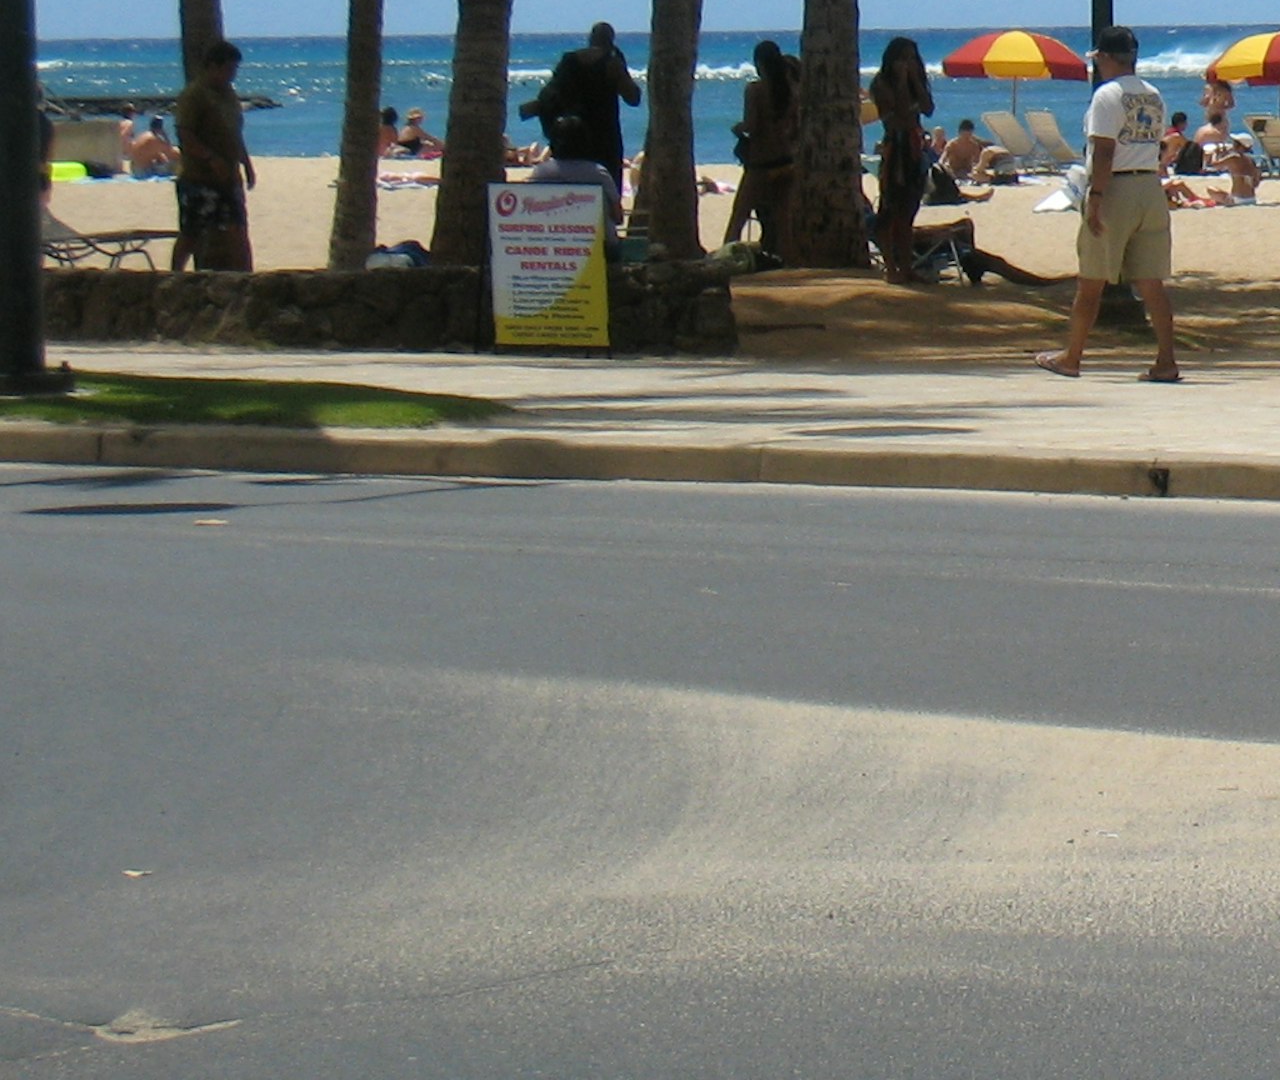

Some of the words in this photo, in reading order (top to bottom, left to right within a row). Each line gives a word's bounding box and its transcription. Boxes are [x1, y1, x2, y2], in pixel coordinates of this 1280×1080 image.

[498, 223, 545, 233] SURFING
[548, 224, 597, 235] LESSONS
[504, 245, 549, 256] CANOE
[553, 246, 592, 257] RIDES
[519, 261, 578, 272] RENTALS
